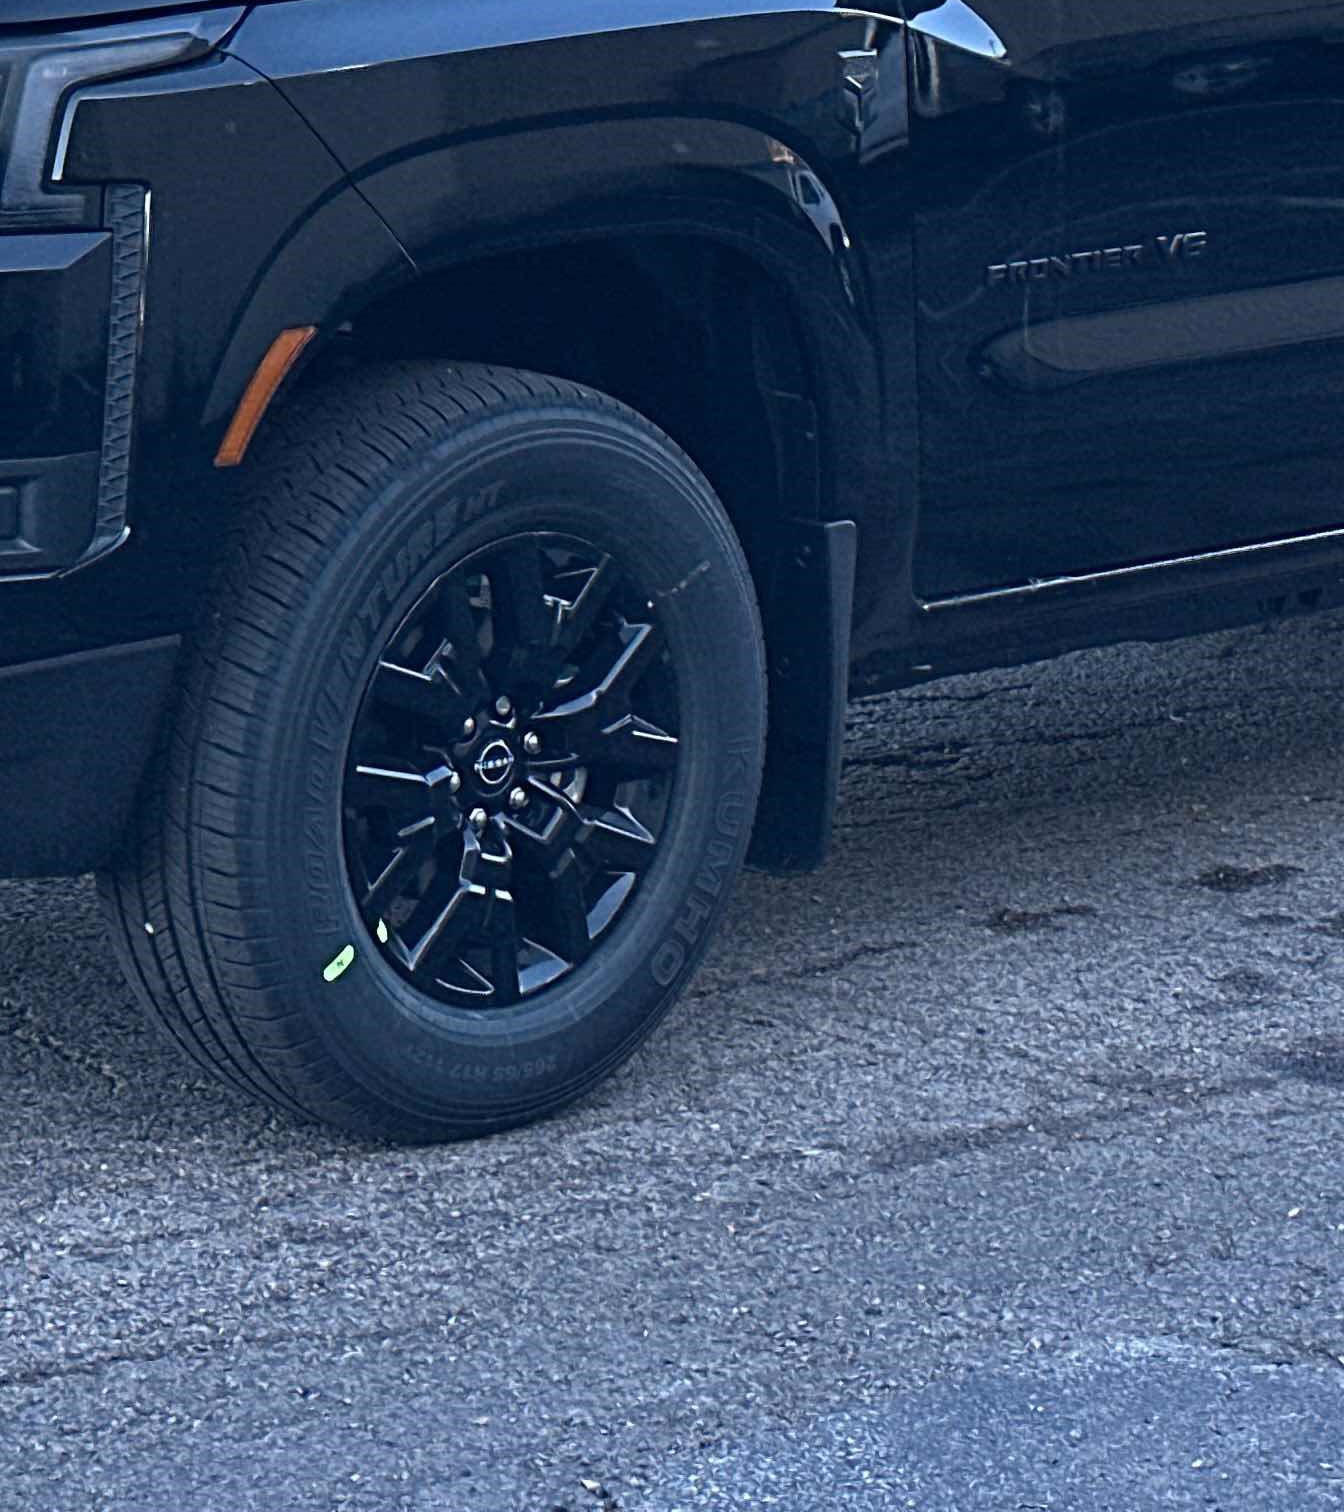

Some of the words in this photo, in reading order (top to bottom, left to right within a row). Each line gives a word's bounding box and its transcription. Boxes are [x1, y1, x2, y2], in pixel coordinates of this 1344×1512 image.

[986, 244, 1144, 286] FRONTIER
[1154, 231, 1207, 260] V6
[651, 736, 753, 986] KUMHO
